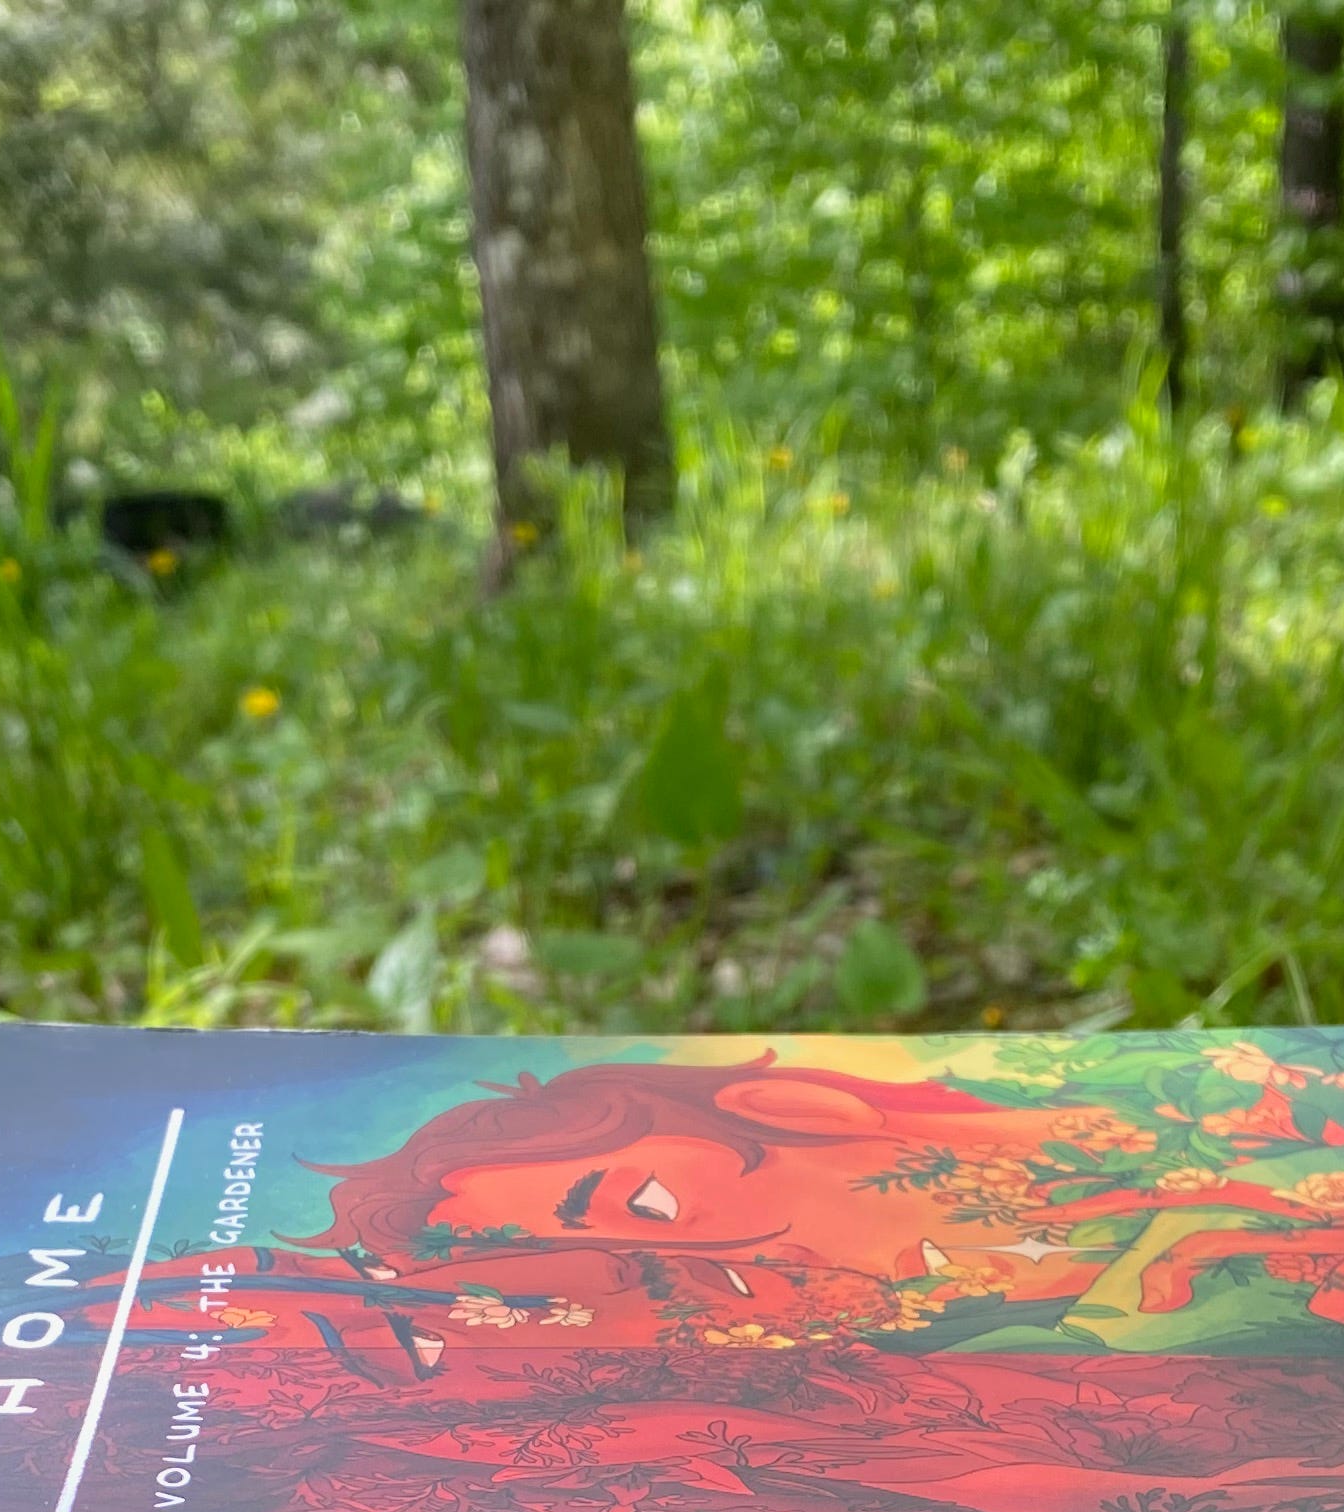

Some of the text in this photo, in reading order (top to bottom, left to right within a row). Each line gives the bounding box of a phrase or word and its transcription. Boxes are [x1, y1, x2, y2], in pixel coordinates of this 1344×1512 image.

[153, 1122, 264, 1508] VOLUME 4: THE GARDENER
